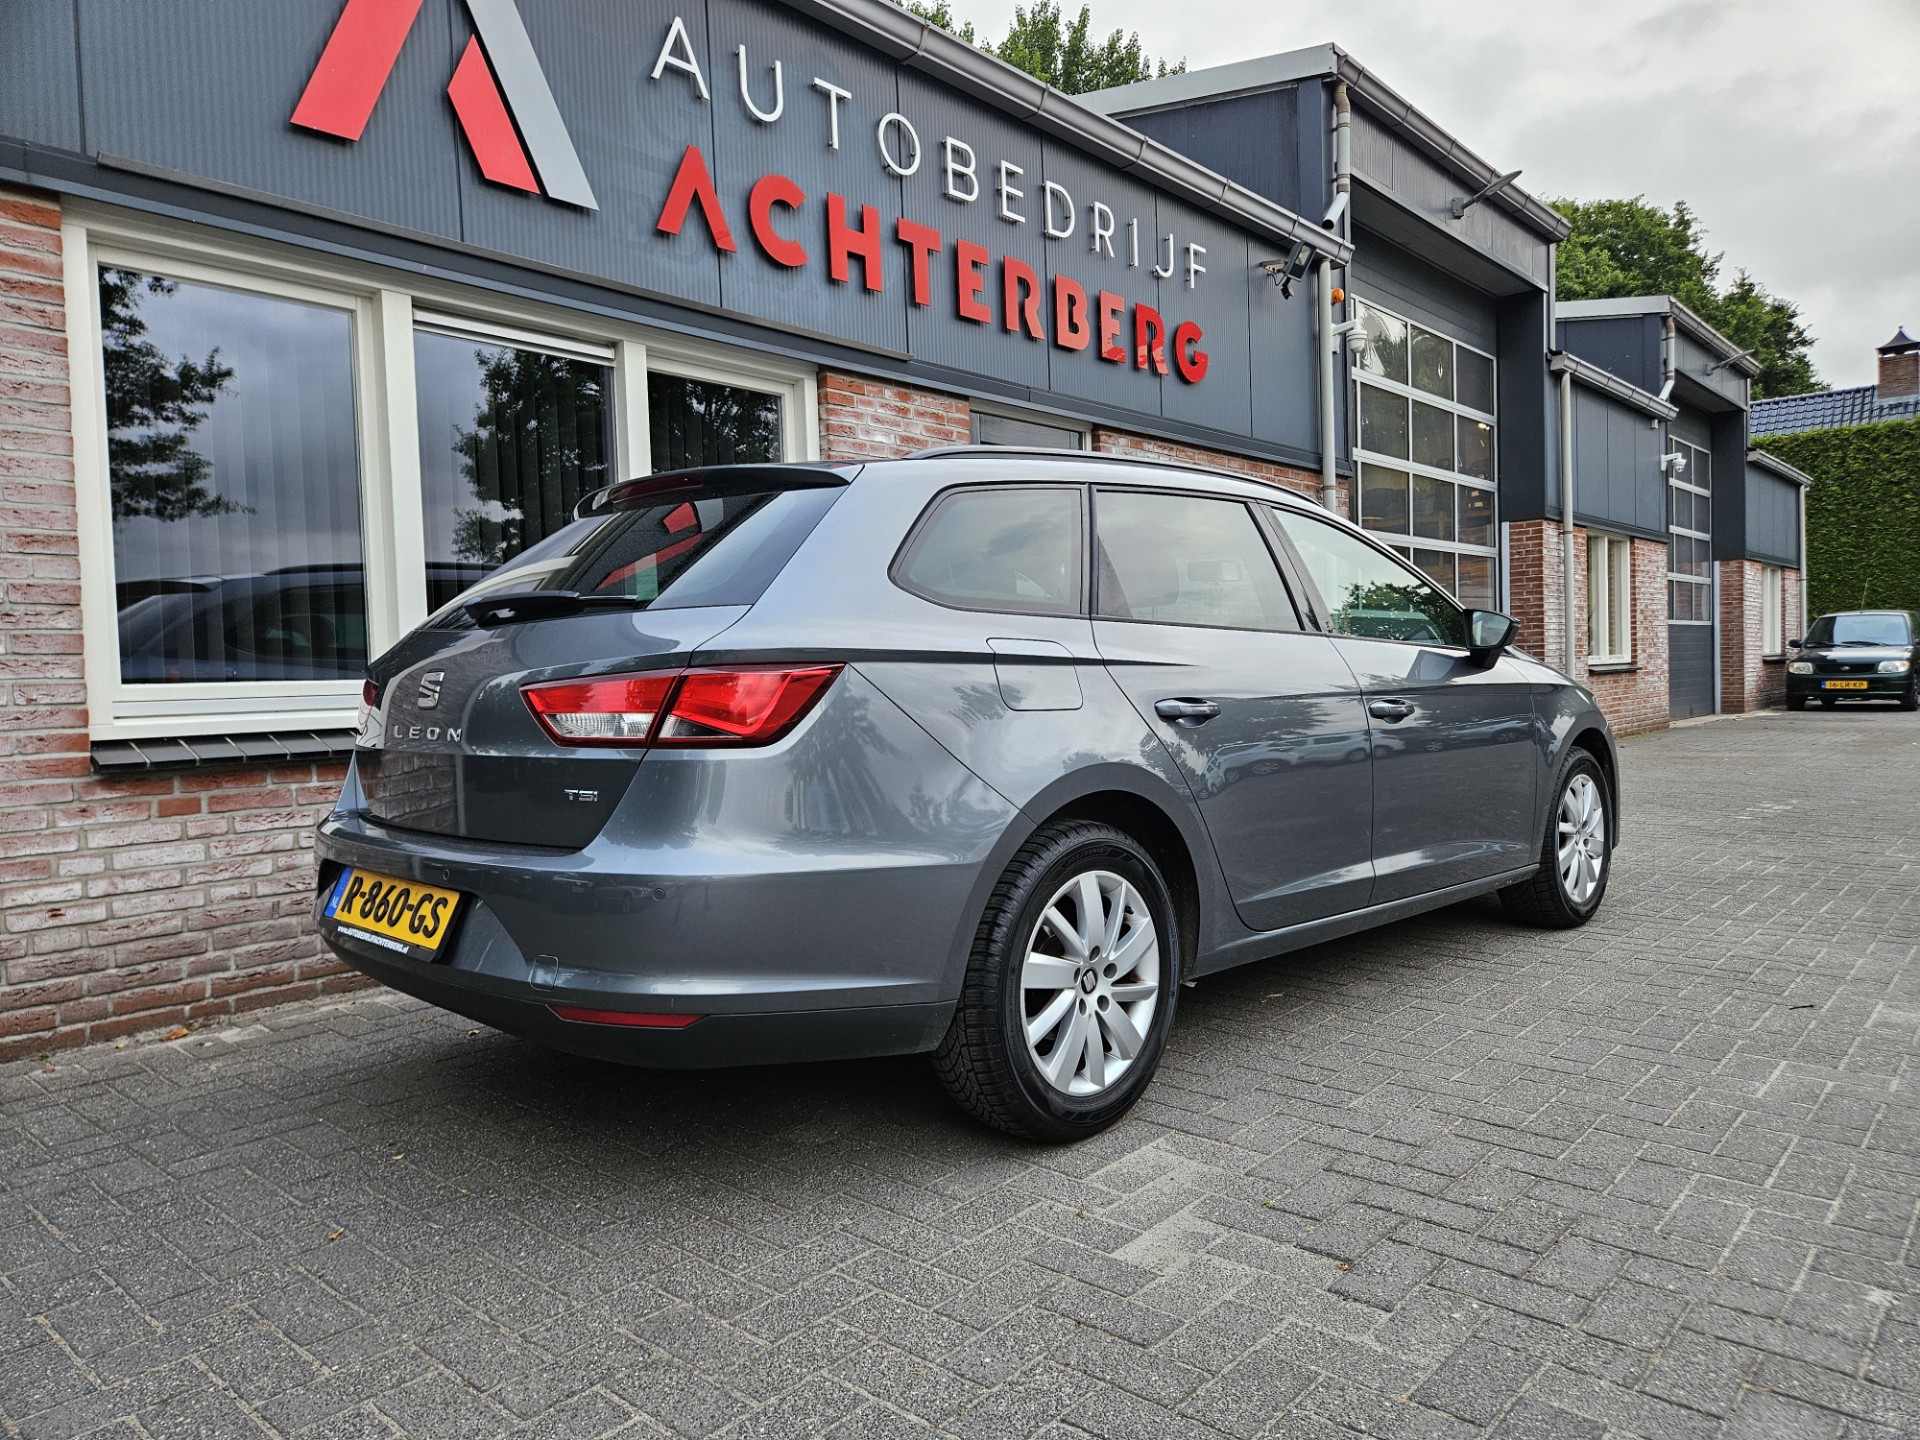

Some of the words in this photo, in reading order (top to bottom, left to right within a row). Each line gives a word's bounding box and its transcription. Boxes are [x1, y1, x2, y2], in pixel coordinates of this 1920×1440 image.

[651, 16, 1207, 289] AUTOBEDRIJF
[657, 144, 1209, 383] ACHTERBERG
[394, 725, 462, 743] LEON
[341, 876, 448, 938] R-860-GS
